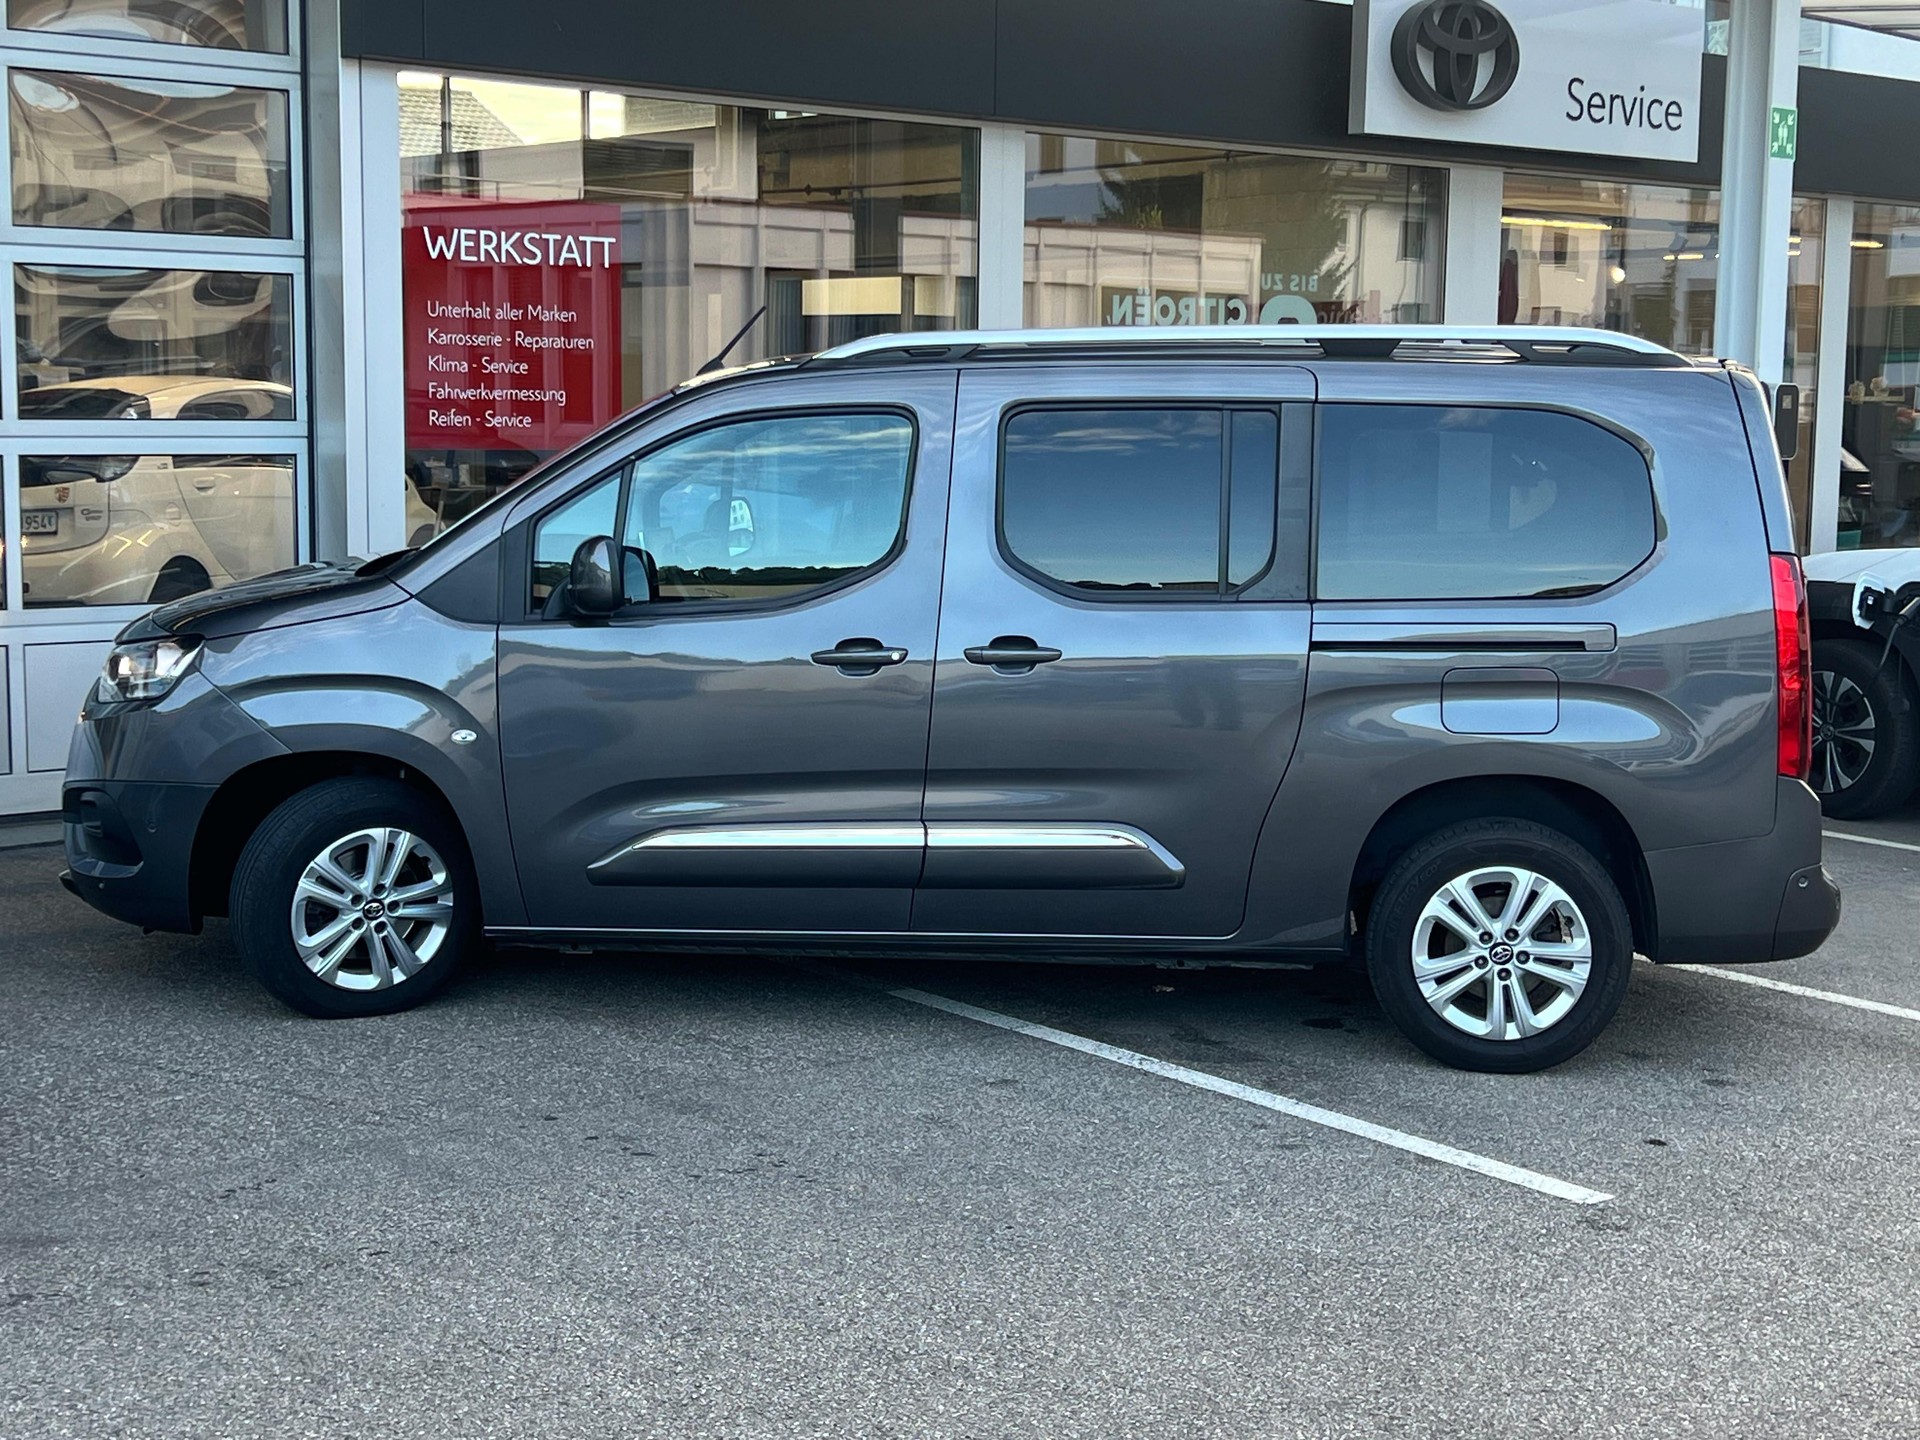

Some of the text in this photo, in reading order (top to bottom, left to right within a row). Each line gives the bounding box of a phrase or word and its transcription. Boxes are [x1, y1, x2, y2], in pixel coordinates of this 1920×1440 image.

[1566, 77, 1683, 131] Service
[423, 226, 617, 269] WERKSTATT
[427, 300, 577, 323] Unterhalt aller Marken
[428, 328, 503, 346] Karrosserie
[515, 331, 594, 351] Reparaturen
[428, 355, 469, 373] Klima
[481, 357, 529, 375] Service
[428, 382, 566, 406] Fahrwerkvermessung
[429, 409, 472, 427] Reifen
[484, 410, 532, 428] Service
